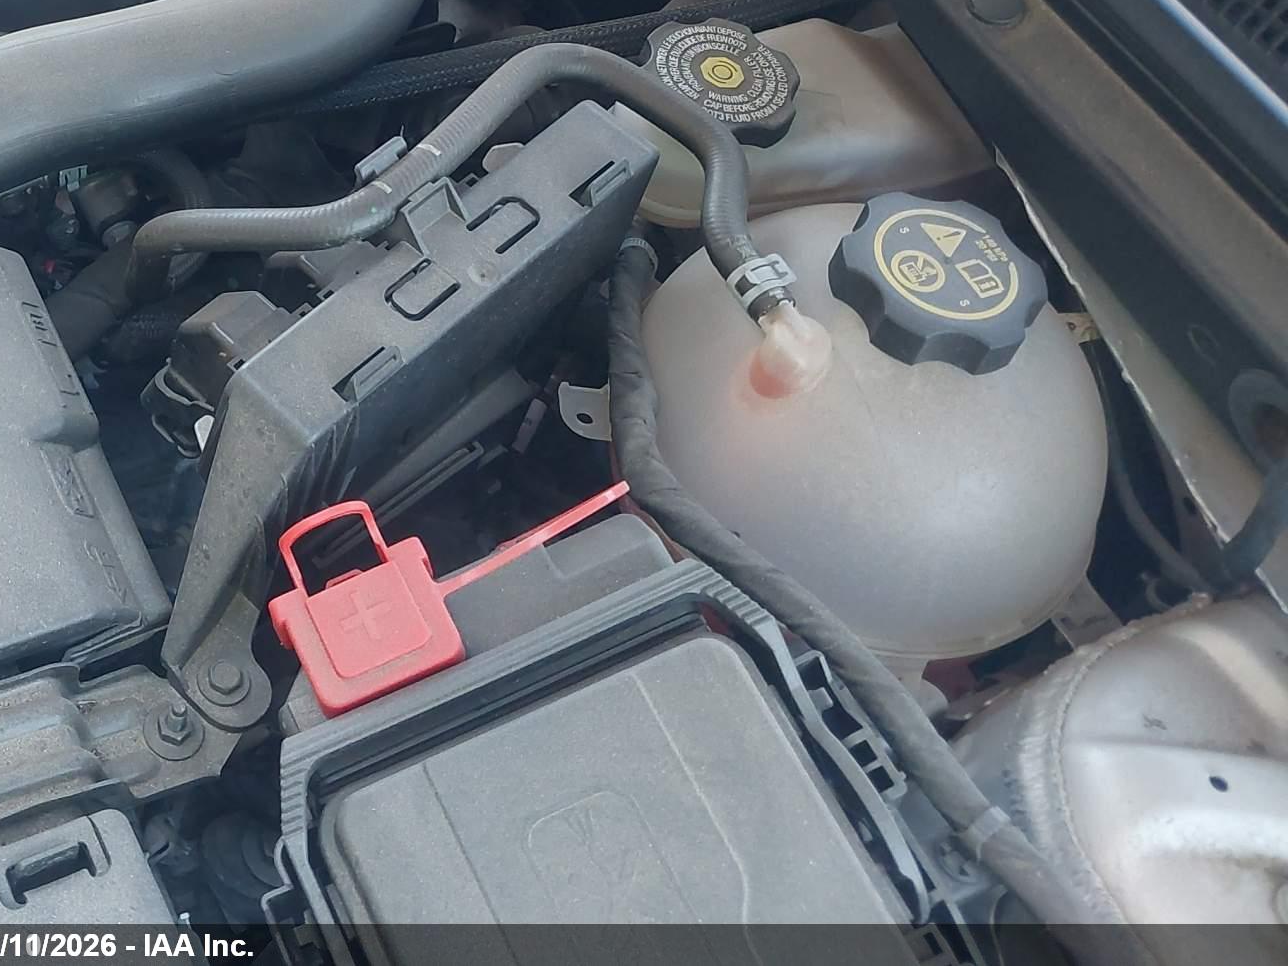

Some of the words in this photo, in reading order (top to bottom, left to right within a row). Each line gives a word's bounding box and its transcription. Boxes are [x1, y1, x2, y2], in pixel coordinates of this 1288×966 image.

[744, 56, 762, 78] FILLER
[752, 51, 769, 67] ONLY
[762, 66, 775, 80] USE
[747, 77, 763, 98] CLEAN
[703, 99, 722, 109] CAP
[723, 101, 755, 113] BEFORE
[725, 112, 751, 122] FLUID
[752, 108, 773, 120] FROM
[774, 81, 788, 106] SEALED
